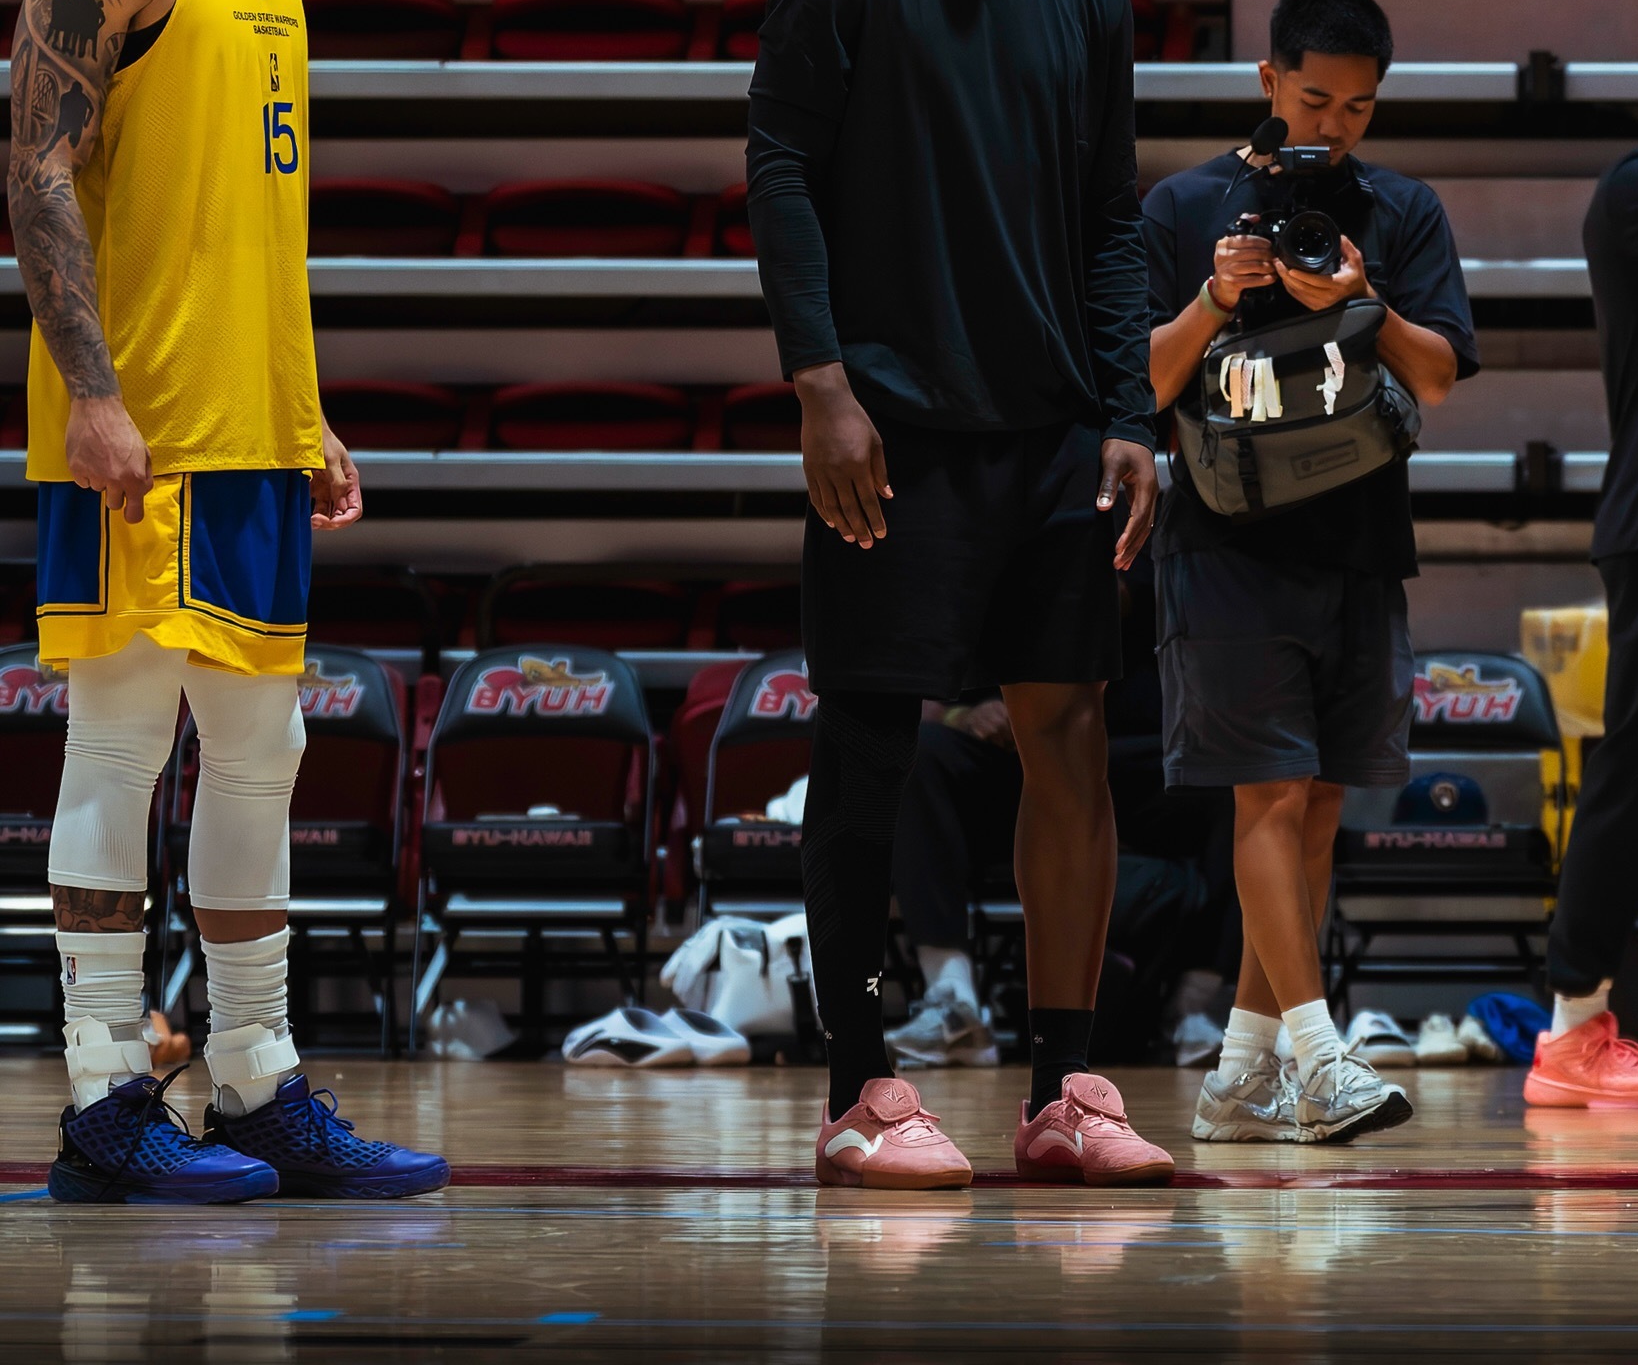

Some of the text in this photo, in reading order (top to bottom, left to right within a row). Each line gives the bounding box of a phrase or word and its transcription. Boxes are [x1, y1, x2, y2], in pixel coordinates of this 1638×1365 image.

[233, 10, 257, 22] GOLDEN
[257, 12, 275, 24] STATE
[253, 24, 290, 37] BASKETBALL
[262, 101, 299, 175] 15
[465, 681, 616, 718] BYUH
[1413, 691, 1526, 723] YUH
